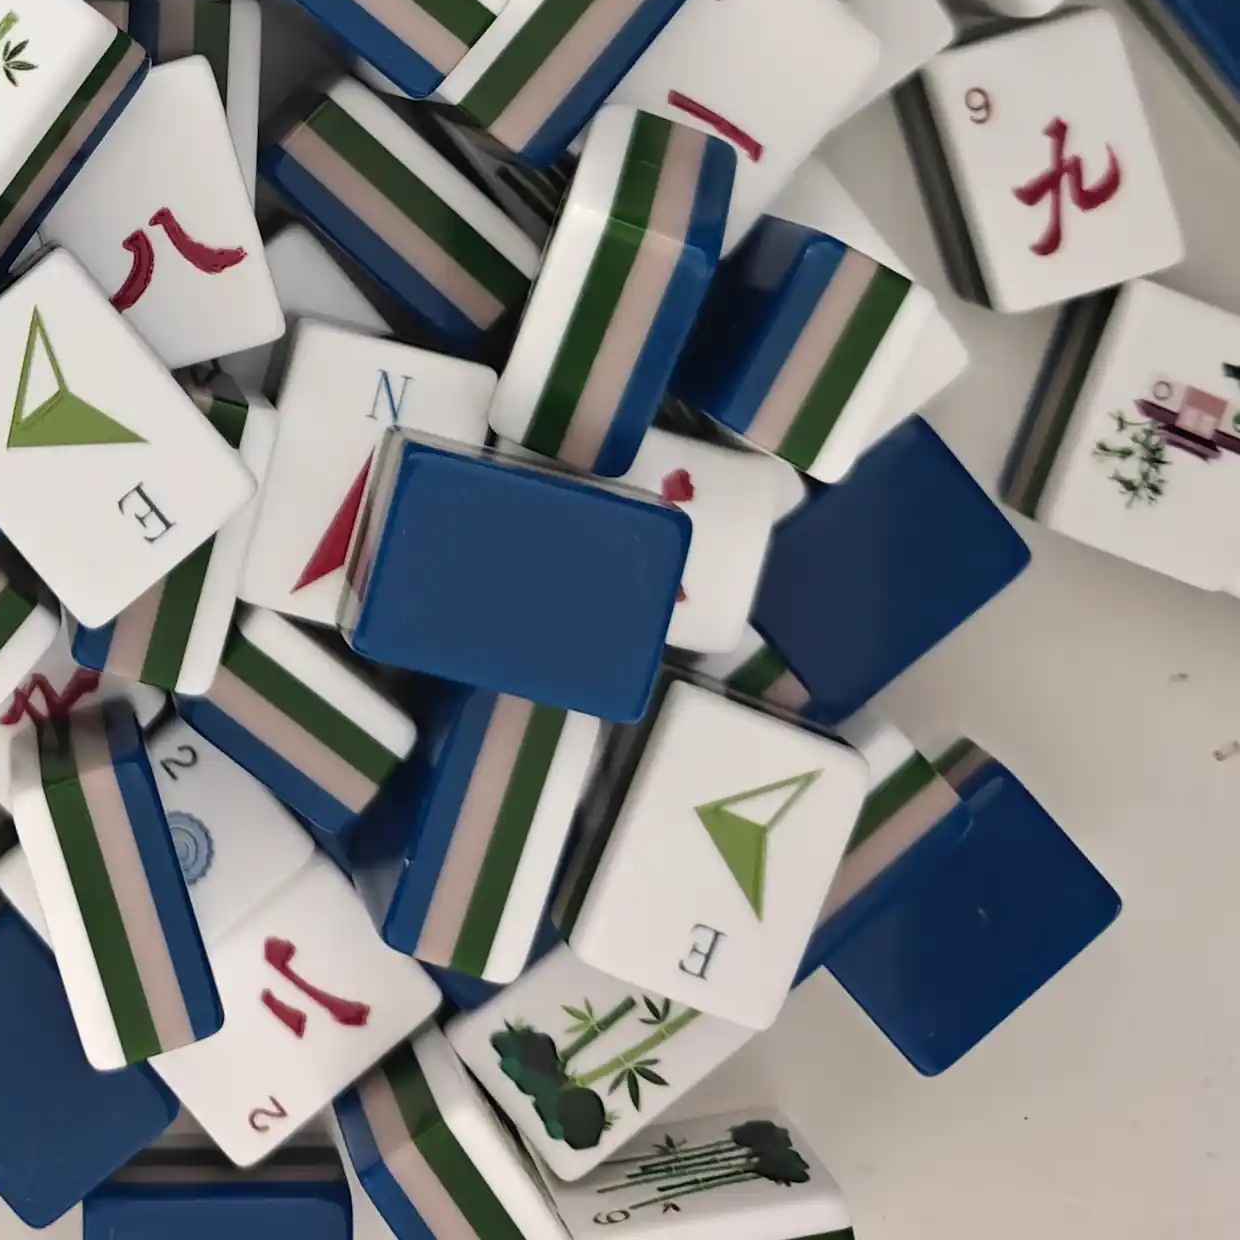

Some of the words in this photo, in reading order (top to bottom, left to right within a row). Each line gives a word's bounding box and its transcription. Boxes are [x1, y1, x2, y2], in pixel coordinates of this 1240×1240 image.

[964, 87, 991, 124] 9
[366, 368, 415, 426] N
[117, 481, 177, 544] E
[159, 745, 198, 781] 2
[678, 923, 728, 980] E
[248, 1094, 288, 1132] 2
